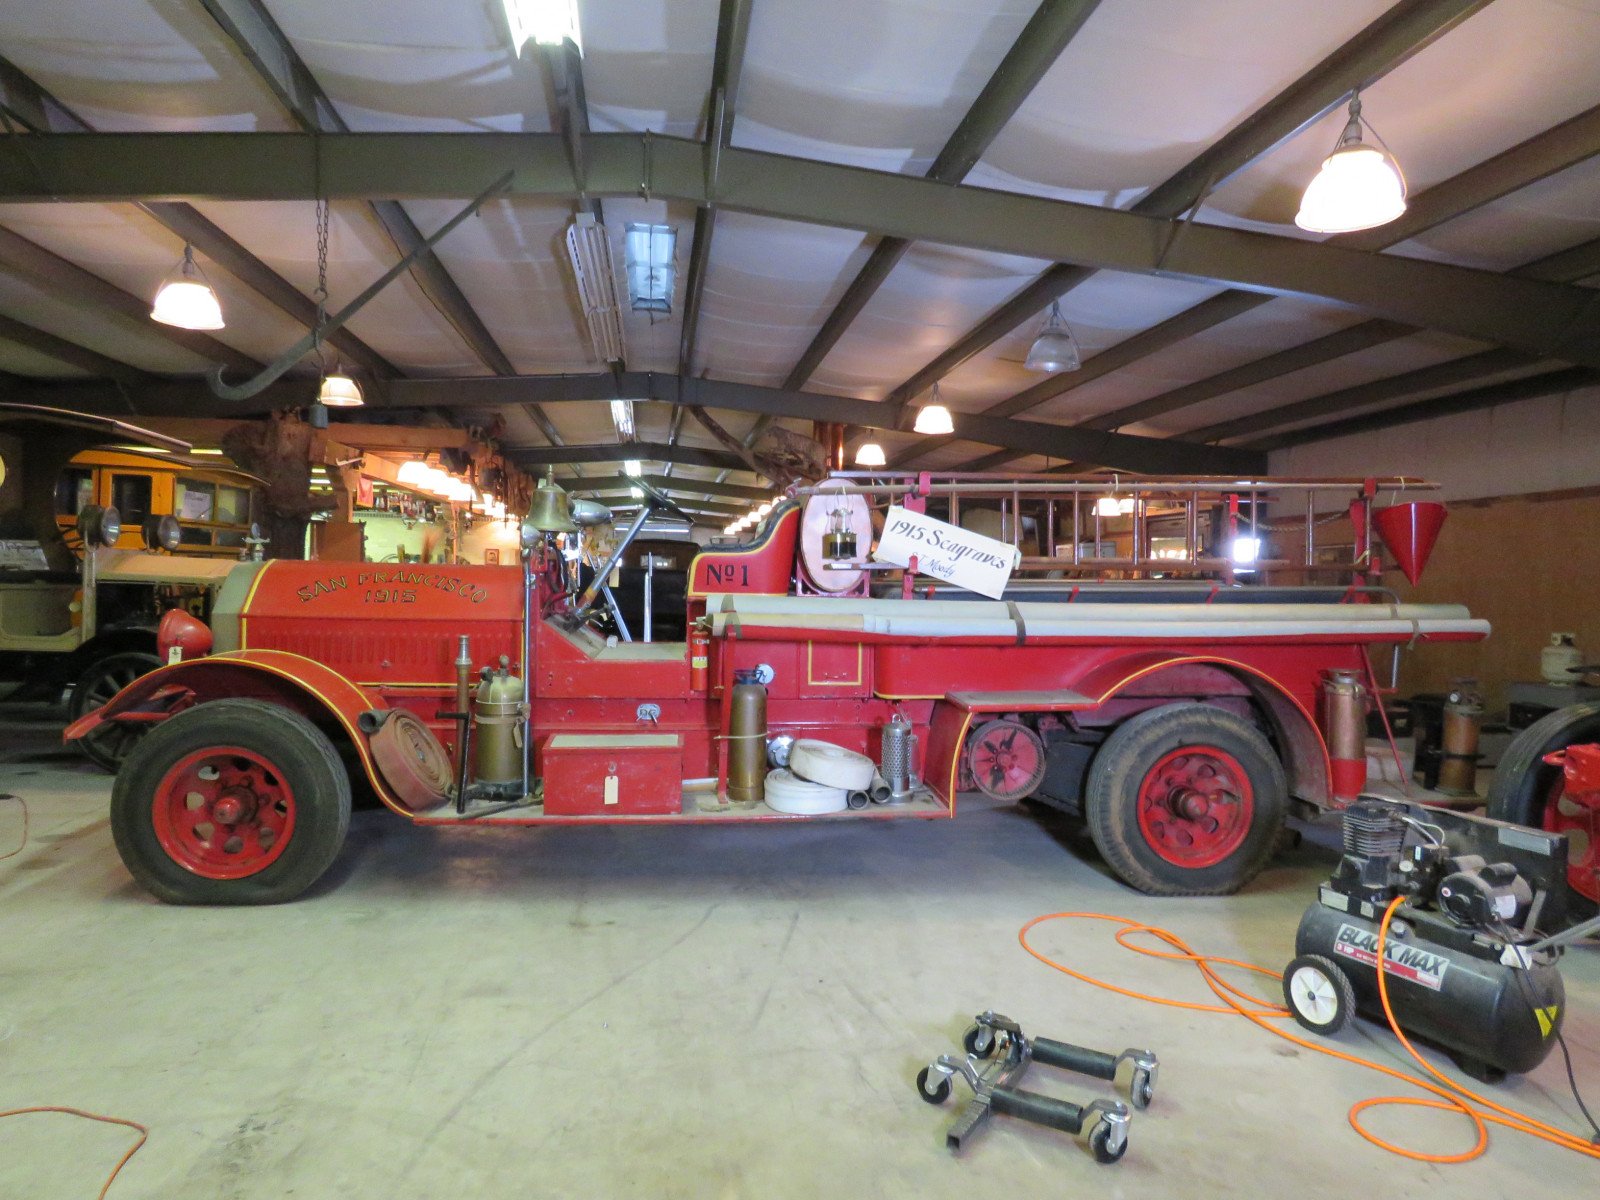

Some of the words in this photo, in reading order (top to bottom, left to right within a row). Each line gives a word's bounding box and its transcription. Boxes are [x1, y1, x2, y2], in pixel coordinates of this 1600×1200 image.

[890, 520, 926, 540] 1915
[926, 529, 1005, 569] Seagraves
[741, 564, 749, 587] 1
[925, 558, 956, 578] Moody
[297, 576, 347, 602] SAN
[358, 570, 487, 603] FRANCISCO
[365, 589, 416, 603] 1915
[1338, 926, 1401, 959] BLACK
[1398, 947, 1447, 976] MAX
